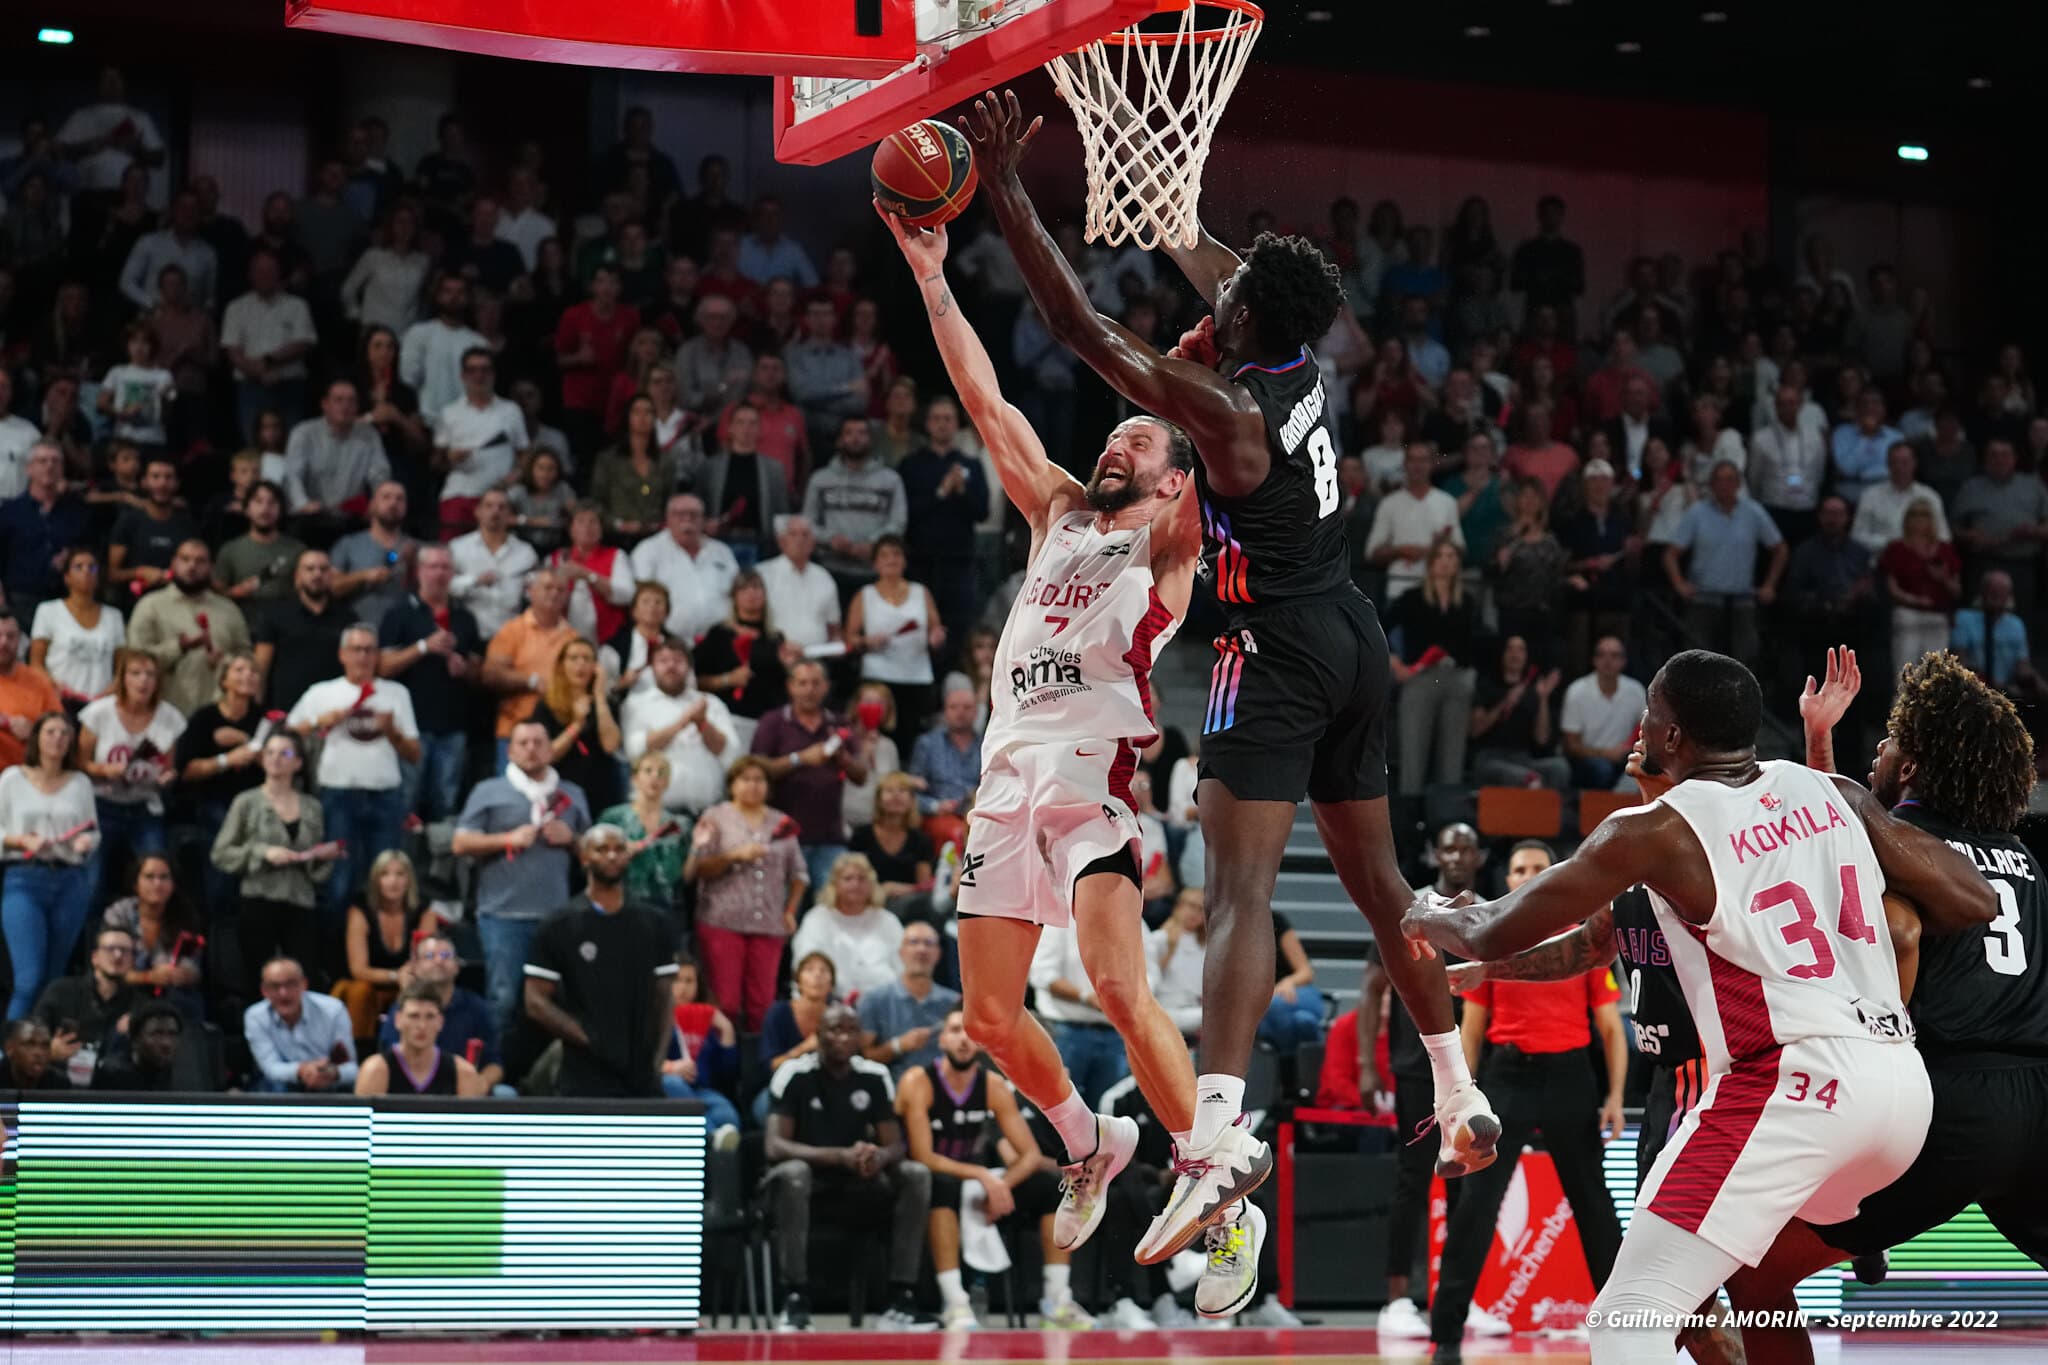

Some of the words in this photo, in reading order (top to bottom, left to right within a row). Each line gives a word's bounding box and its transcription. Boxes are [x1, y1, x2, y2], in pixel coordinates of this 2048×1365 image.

[1307, 425, 1340, 520] 8
[1045, 615, 1070, 638] 7
[1030, 645, 1082, 663] Charles
[1037, 685, 1092, 702] rangements
[1728, 801, 1847, 864] KOKILA
[1750, 865, 1876, 979] 34
[1983, 878, 2028, 976] 3
[1785, 1071, 1839, 1111] 34
